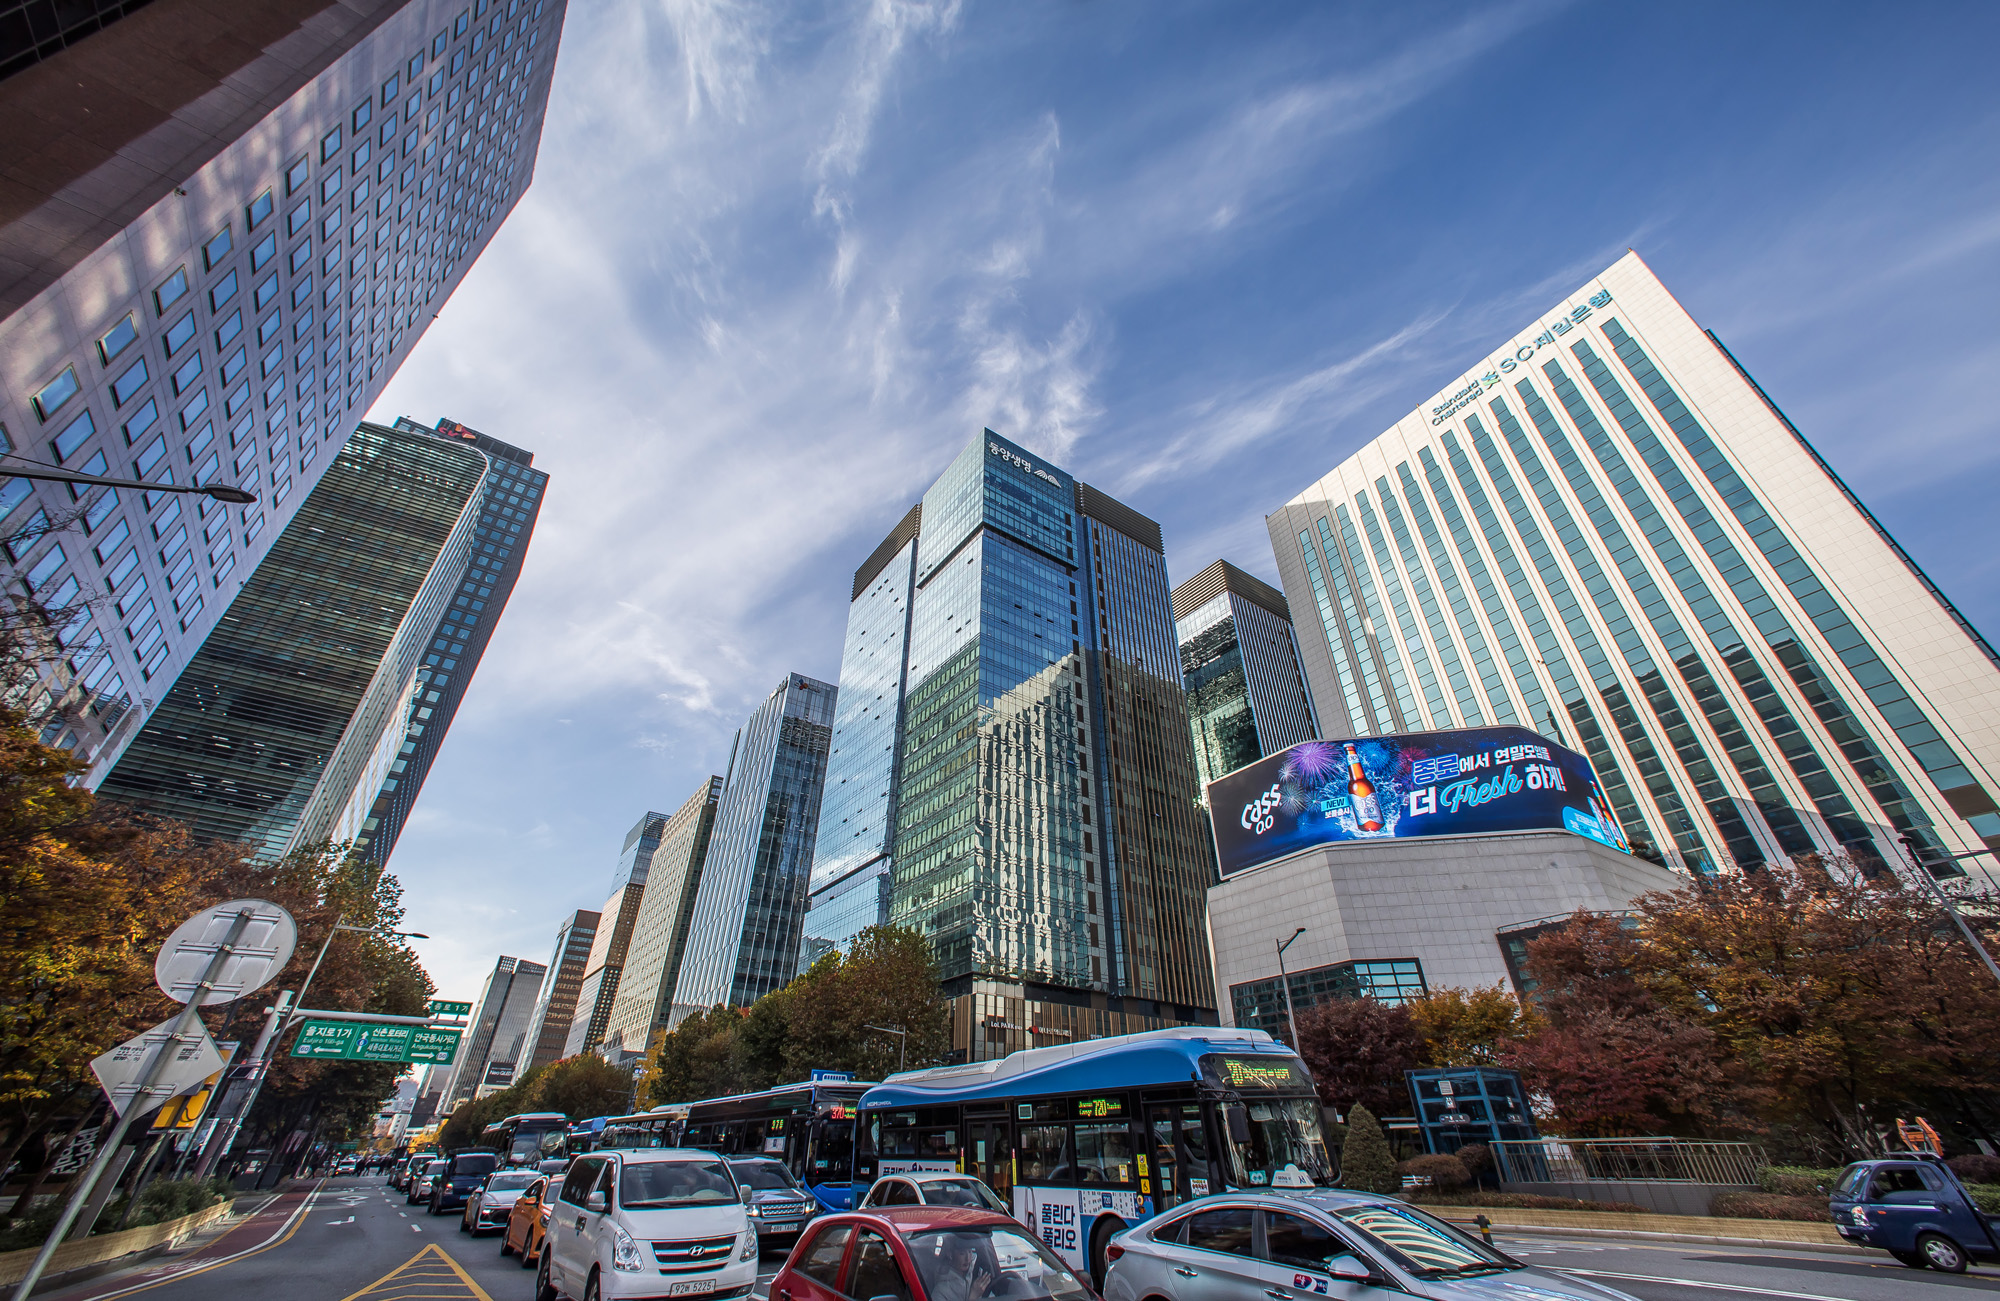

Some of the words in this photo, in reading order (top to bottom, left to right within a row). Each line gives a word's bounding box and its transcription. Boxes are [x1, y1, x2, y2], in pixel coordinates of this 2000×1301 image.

[1499, 289, 1613, 374] SC제일은행
[1432, 380, 1479, 415] Standard
[1432, 388, 1484, 426] Chartered
[989, 441, 1032, 473] 동양생명
[1412, 752, 1490, 785] 종로에서
[1410, 786, 1437, 817] 더
[1440, 764, 1524, 814] Fresh
[1525, 763, 1567, 792] 하게!
[1325, 798, 1345, 809] NEW
[1255, 814, 1274, 834] 0.0
[305, 1026, 353, 1038] 을지로1가
[414, 1033, 457, 1044] 안국동사거리
[831, 1106, 845, 1119] 370
[1093, 1099, 1107, 1117] 720
[1041, 1203, 1076, 1226] 풀린다
[1043, 1226, 1077, 1251] 풀리오
[693, 1281, 712, 1292] 5225
